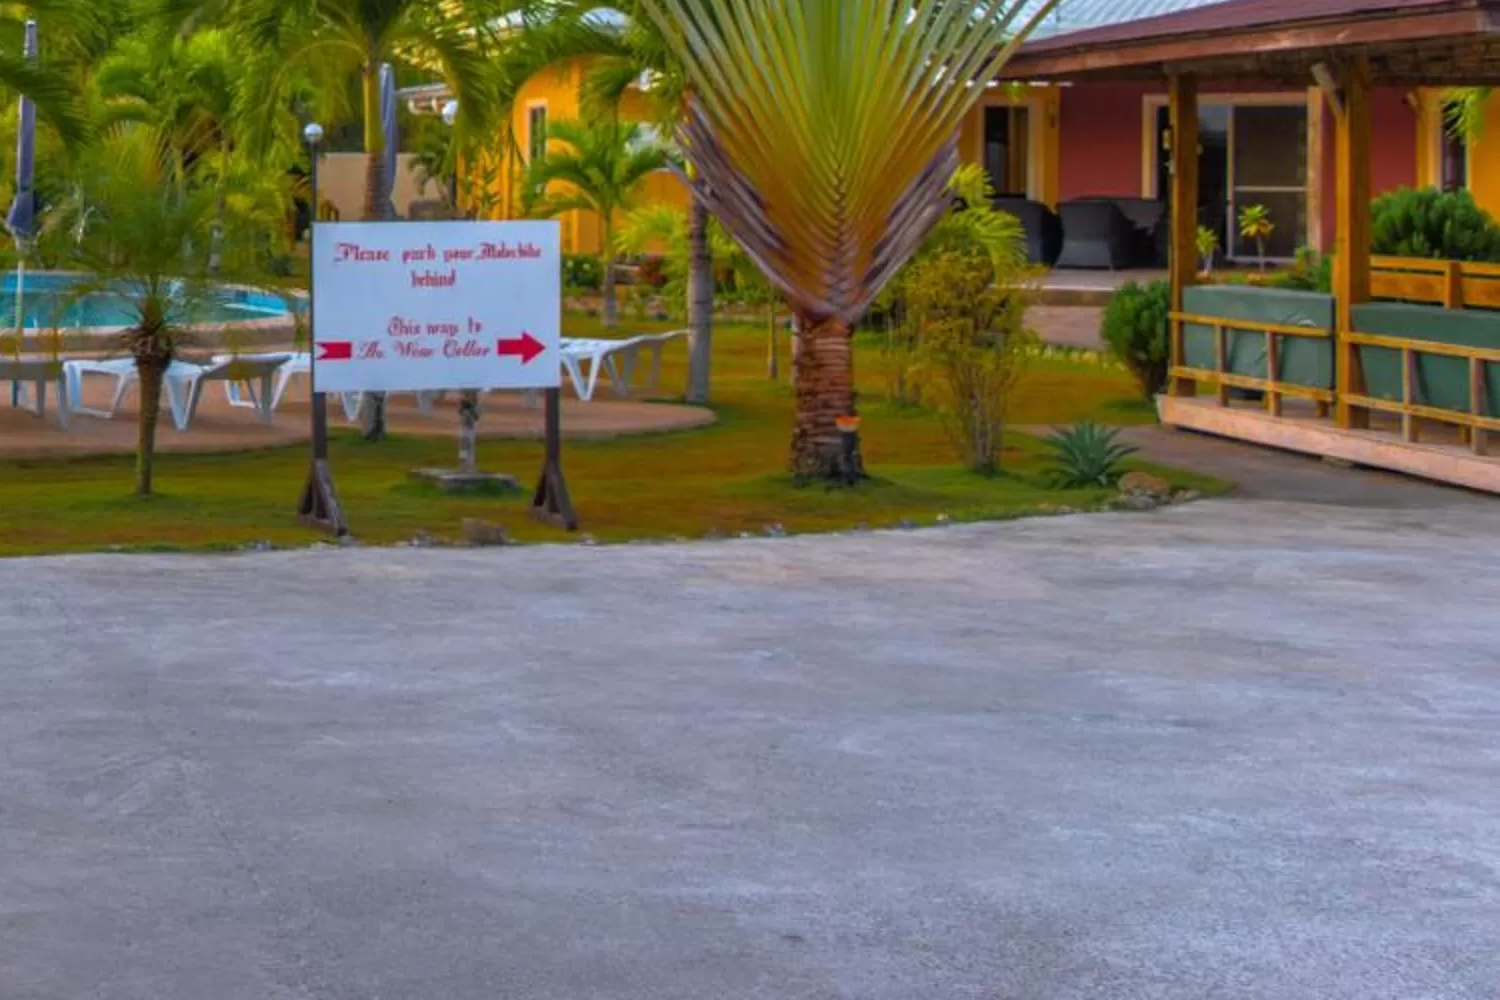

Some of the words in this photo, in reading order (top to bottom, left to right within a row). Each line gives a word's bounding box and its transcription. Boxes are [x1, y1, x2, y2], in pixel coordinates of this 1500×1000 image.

[334, 242, 389, 262] Please
[402, 243, 436, 263] park
[443, 248, 474, 262] your
[411, 268, 456, 288] behind
